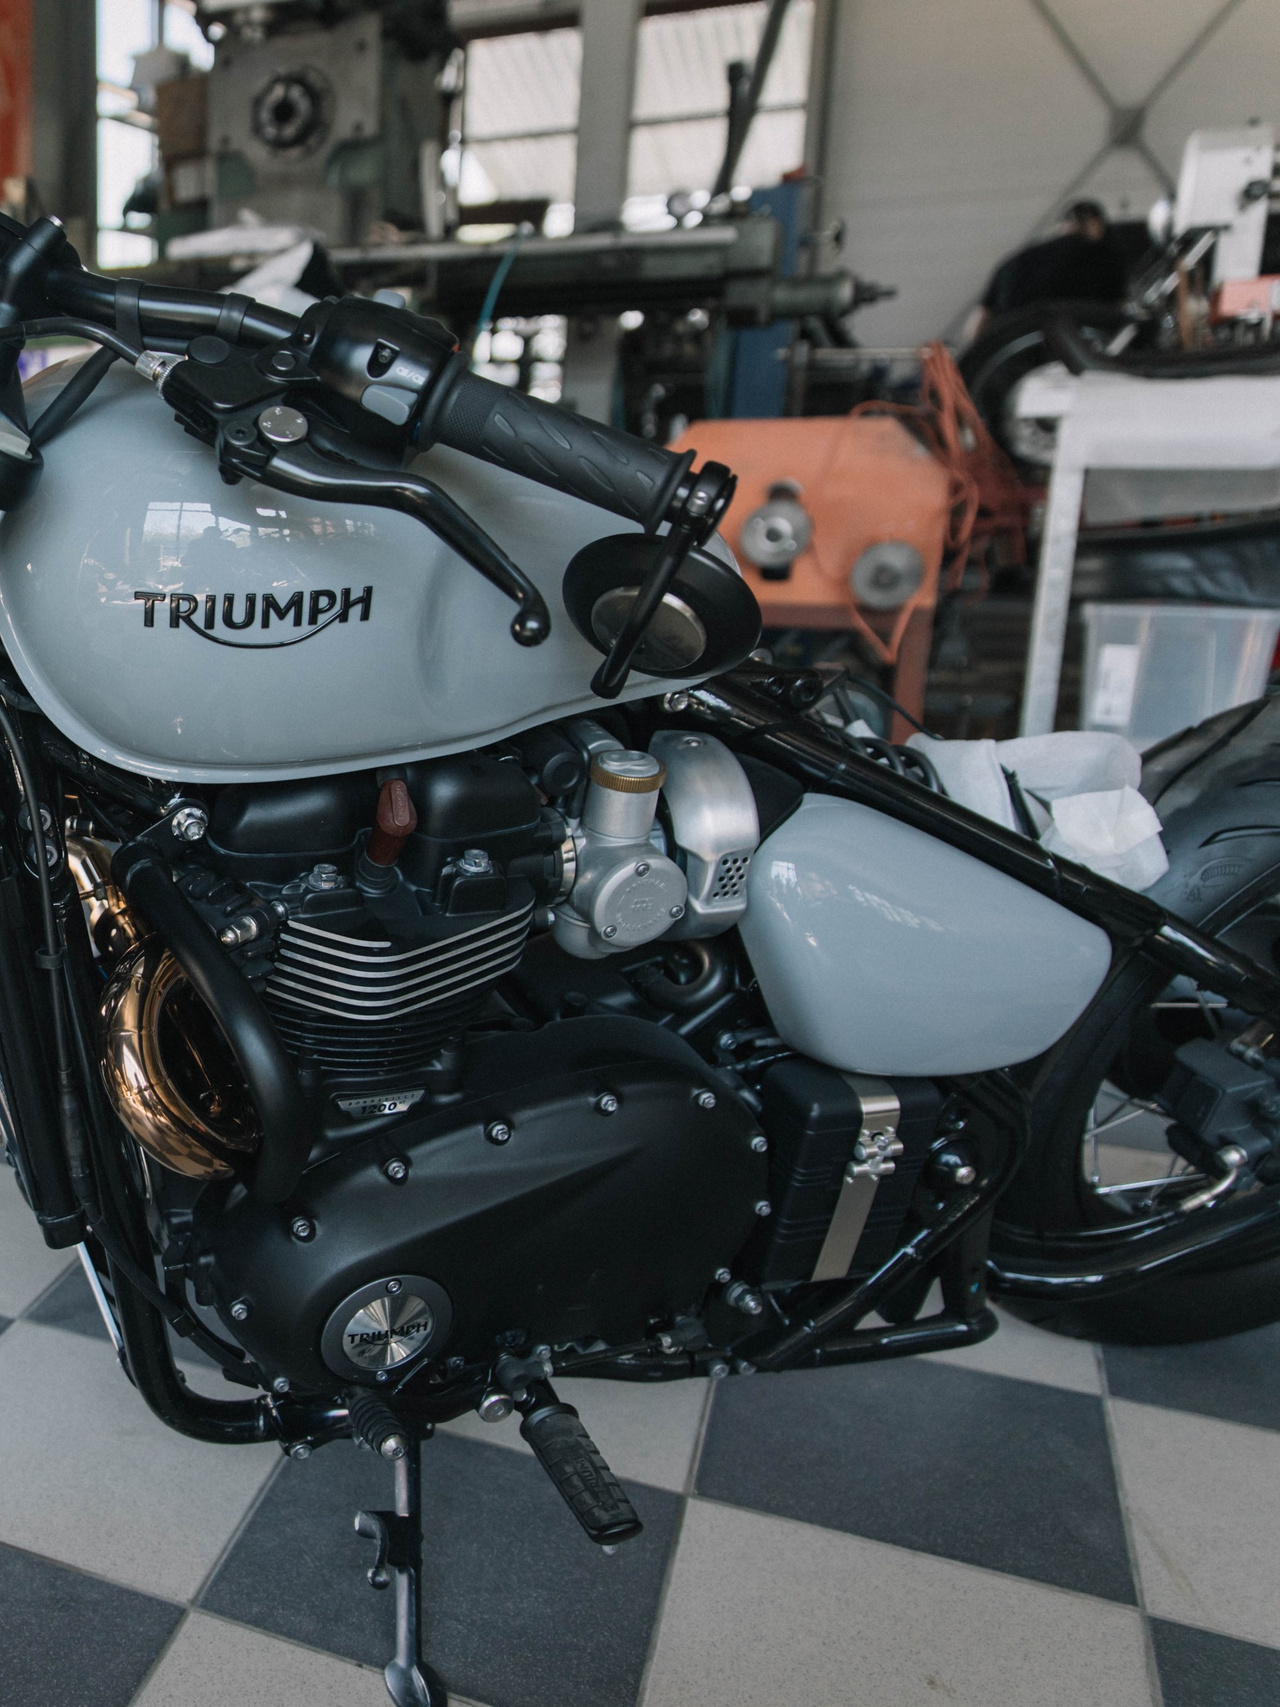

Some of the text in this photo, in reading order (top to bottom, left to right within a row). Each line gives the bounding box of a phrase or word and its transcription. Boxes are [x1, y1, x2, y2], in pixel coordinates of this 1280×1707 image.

[134, 586, 373, 648] TRIUMPH
[361, 1102, 397, 1115] 1200
[347, 1321, 428, 1346] TRIUMPH
